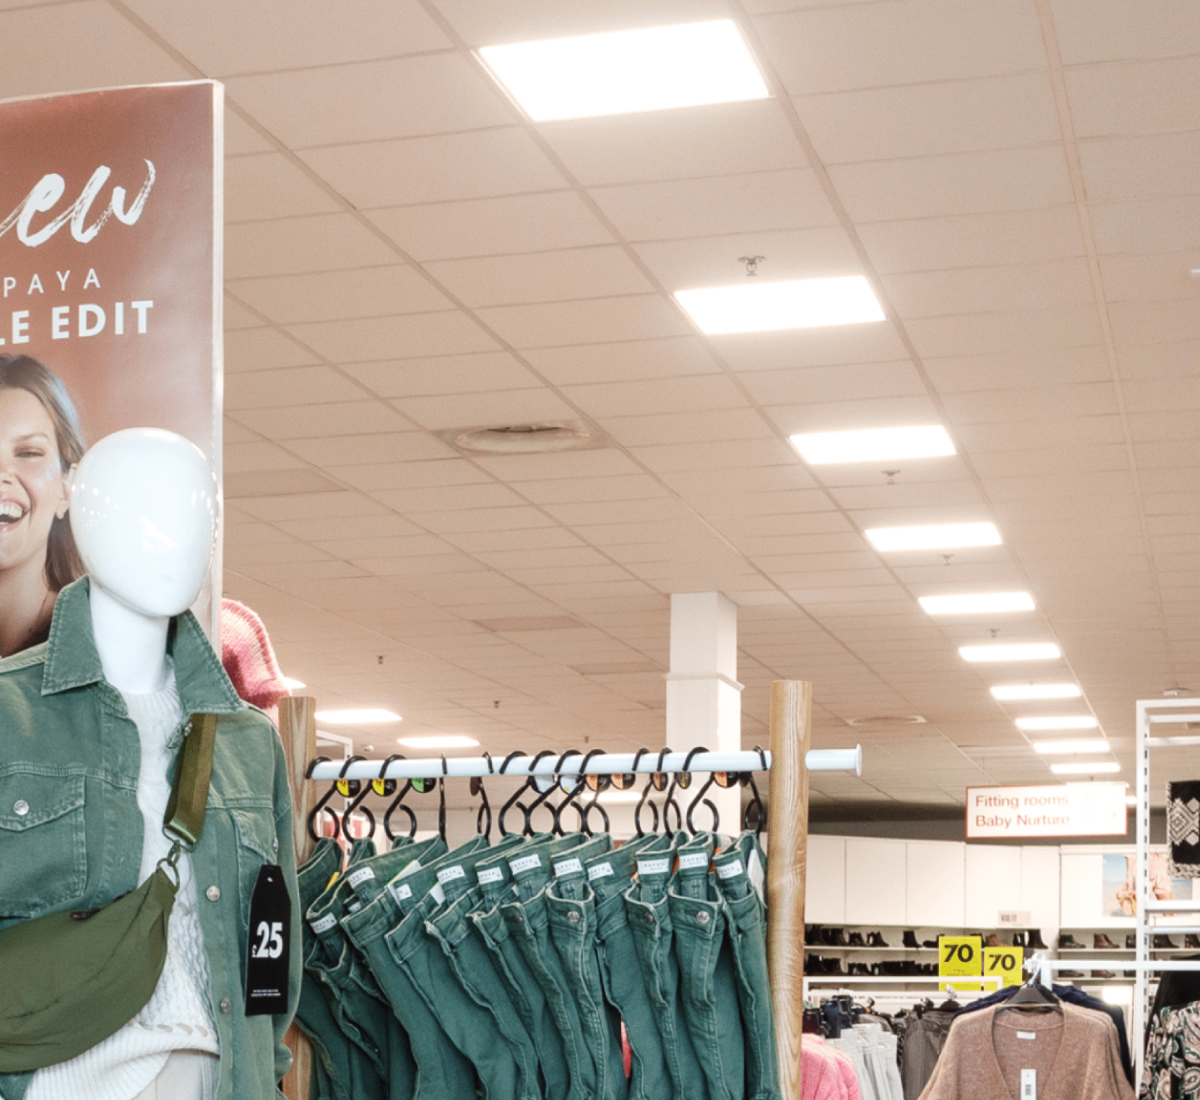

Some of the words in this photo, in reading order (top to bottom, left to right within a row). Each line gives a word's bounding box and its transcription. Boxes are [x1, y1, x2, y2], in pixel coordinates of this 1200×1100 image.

[52, 300, 155, 340] EDIT
[975, 795, 1019, 809] Fitting
[1024, 795, 1069, 806] rooms
[975, 815, 1011, 829] Baby
[1017, 814, 1069, 827] Nurture
[251, 921, 284, 959] £25
[944, 944, 974, 963] 70
